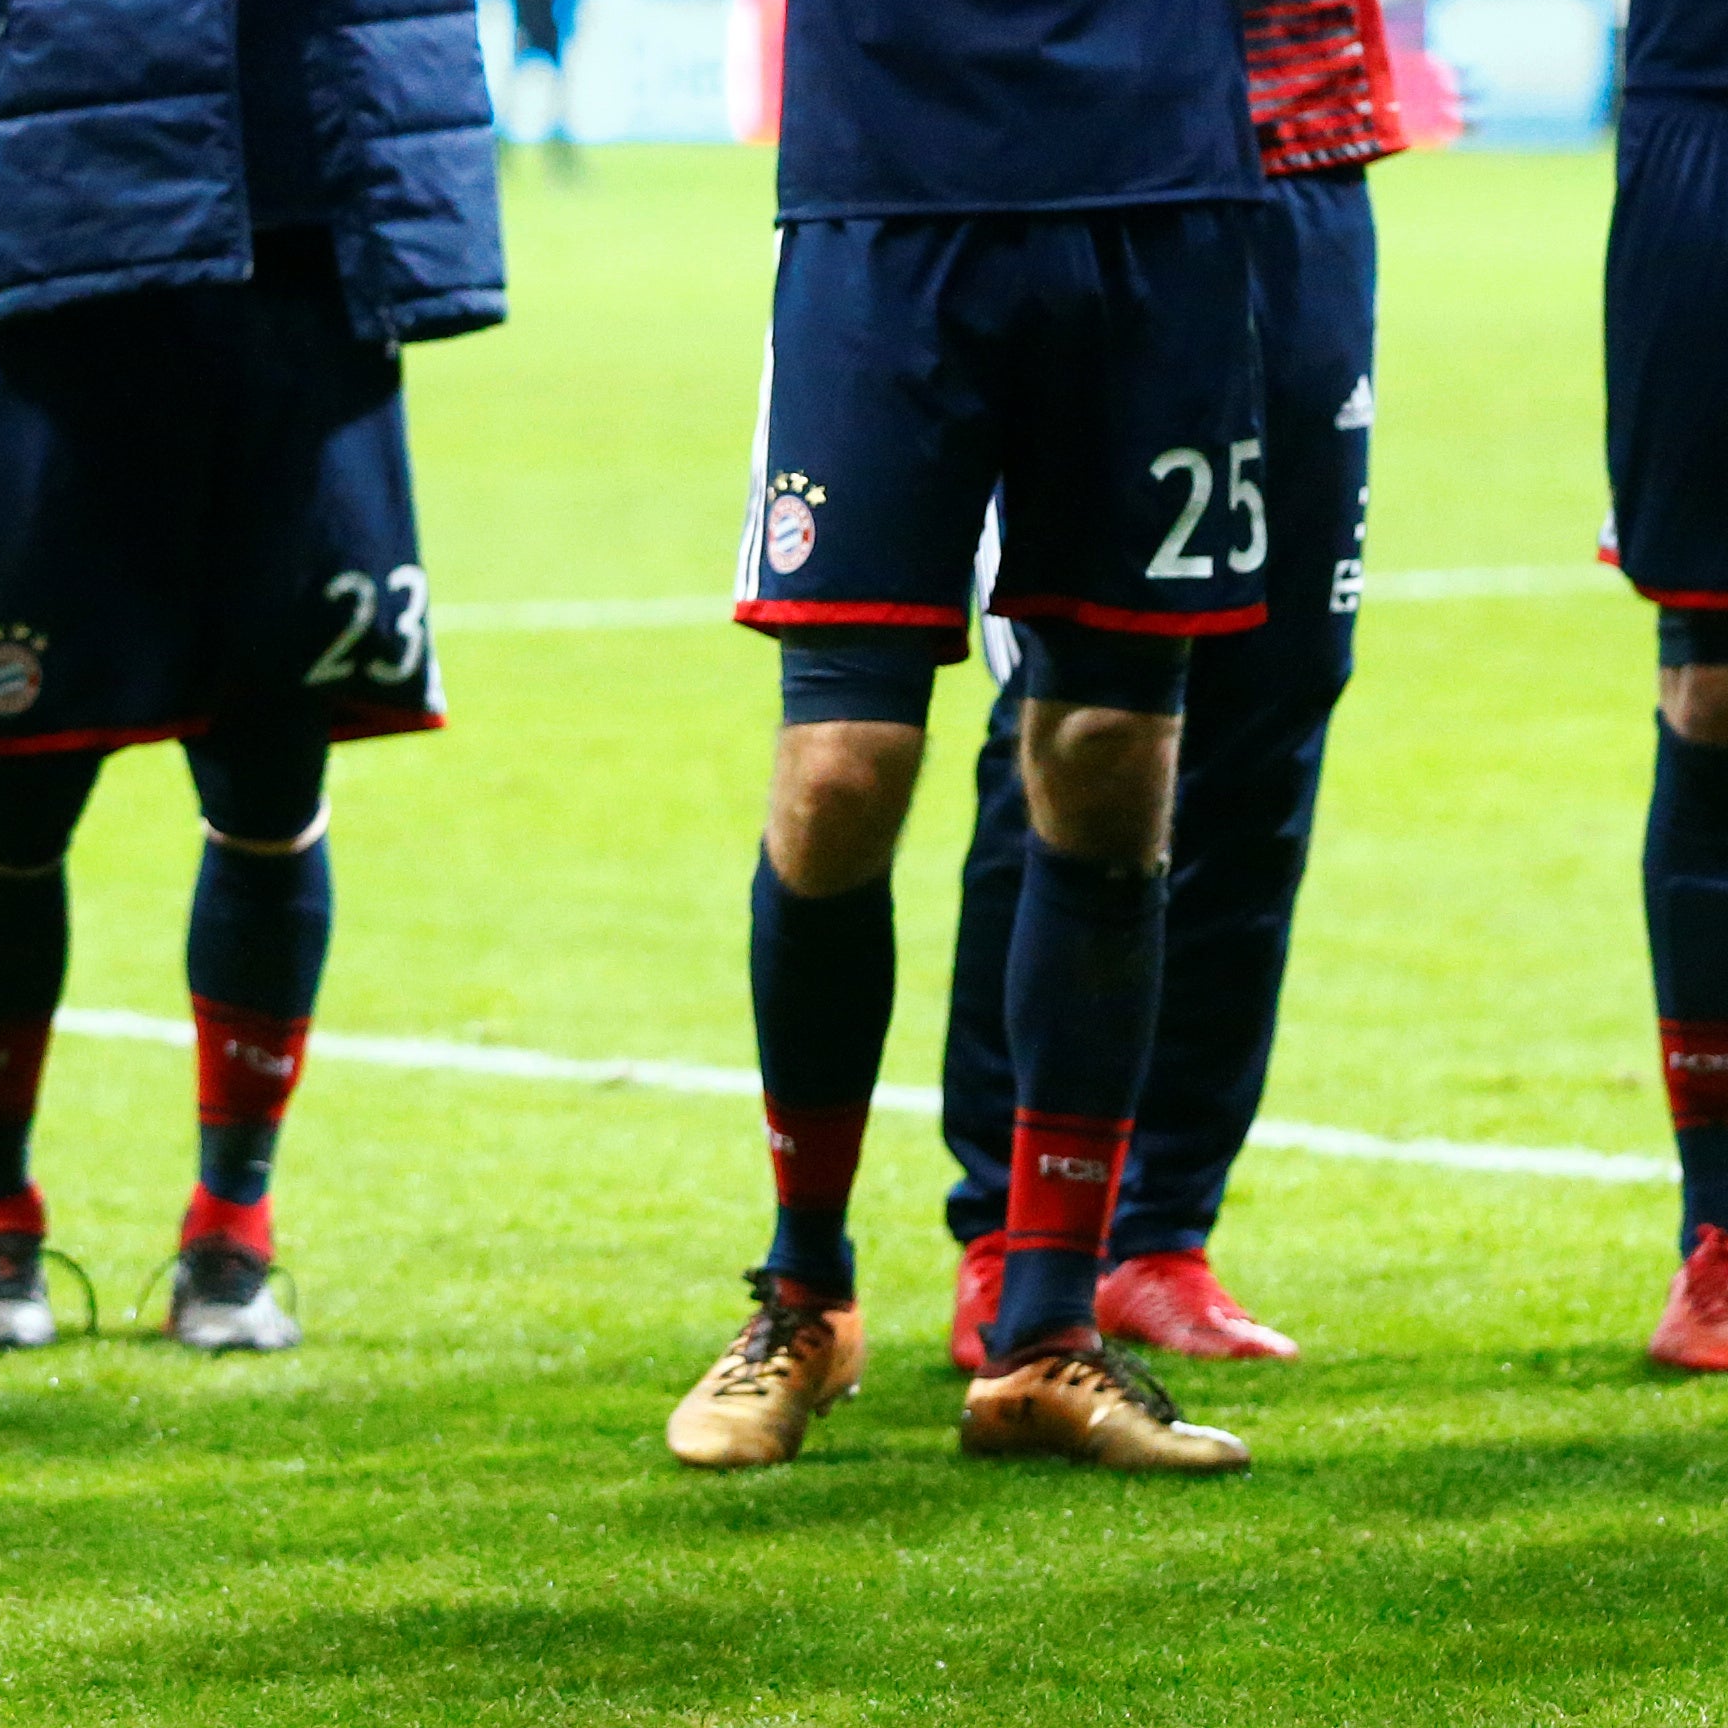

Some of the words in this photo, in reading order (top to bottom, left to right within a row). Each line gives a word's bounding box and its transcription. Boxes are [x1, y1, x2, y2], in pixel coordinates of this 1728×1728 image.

[1145, 438, 1268, 579] 25
[303, 564, 429, 687] 23
[1038, 1154, 1108, 1184] FCB
